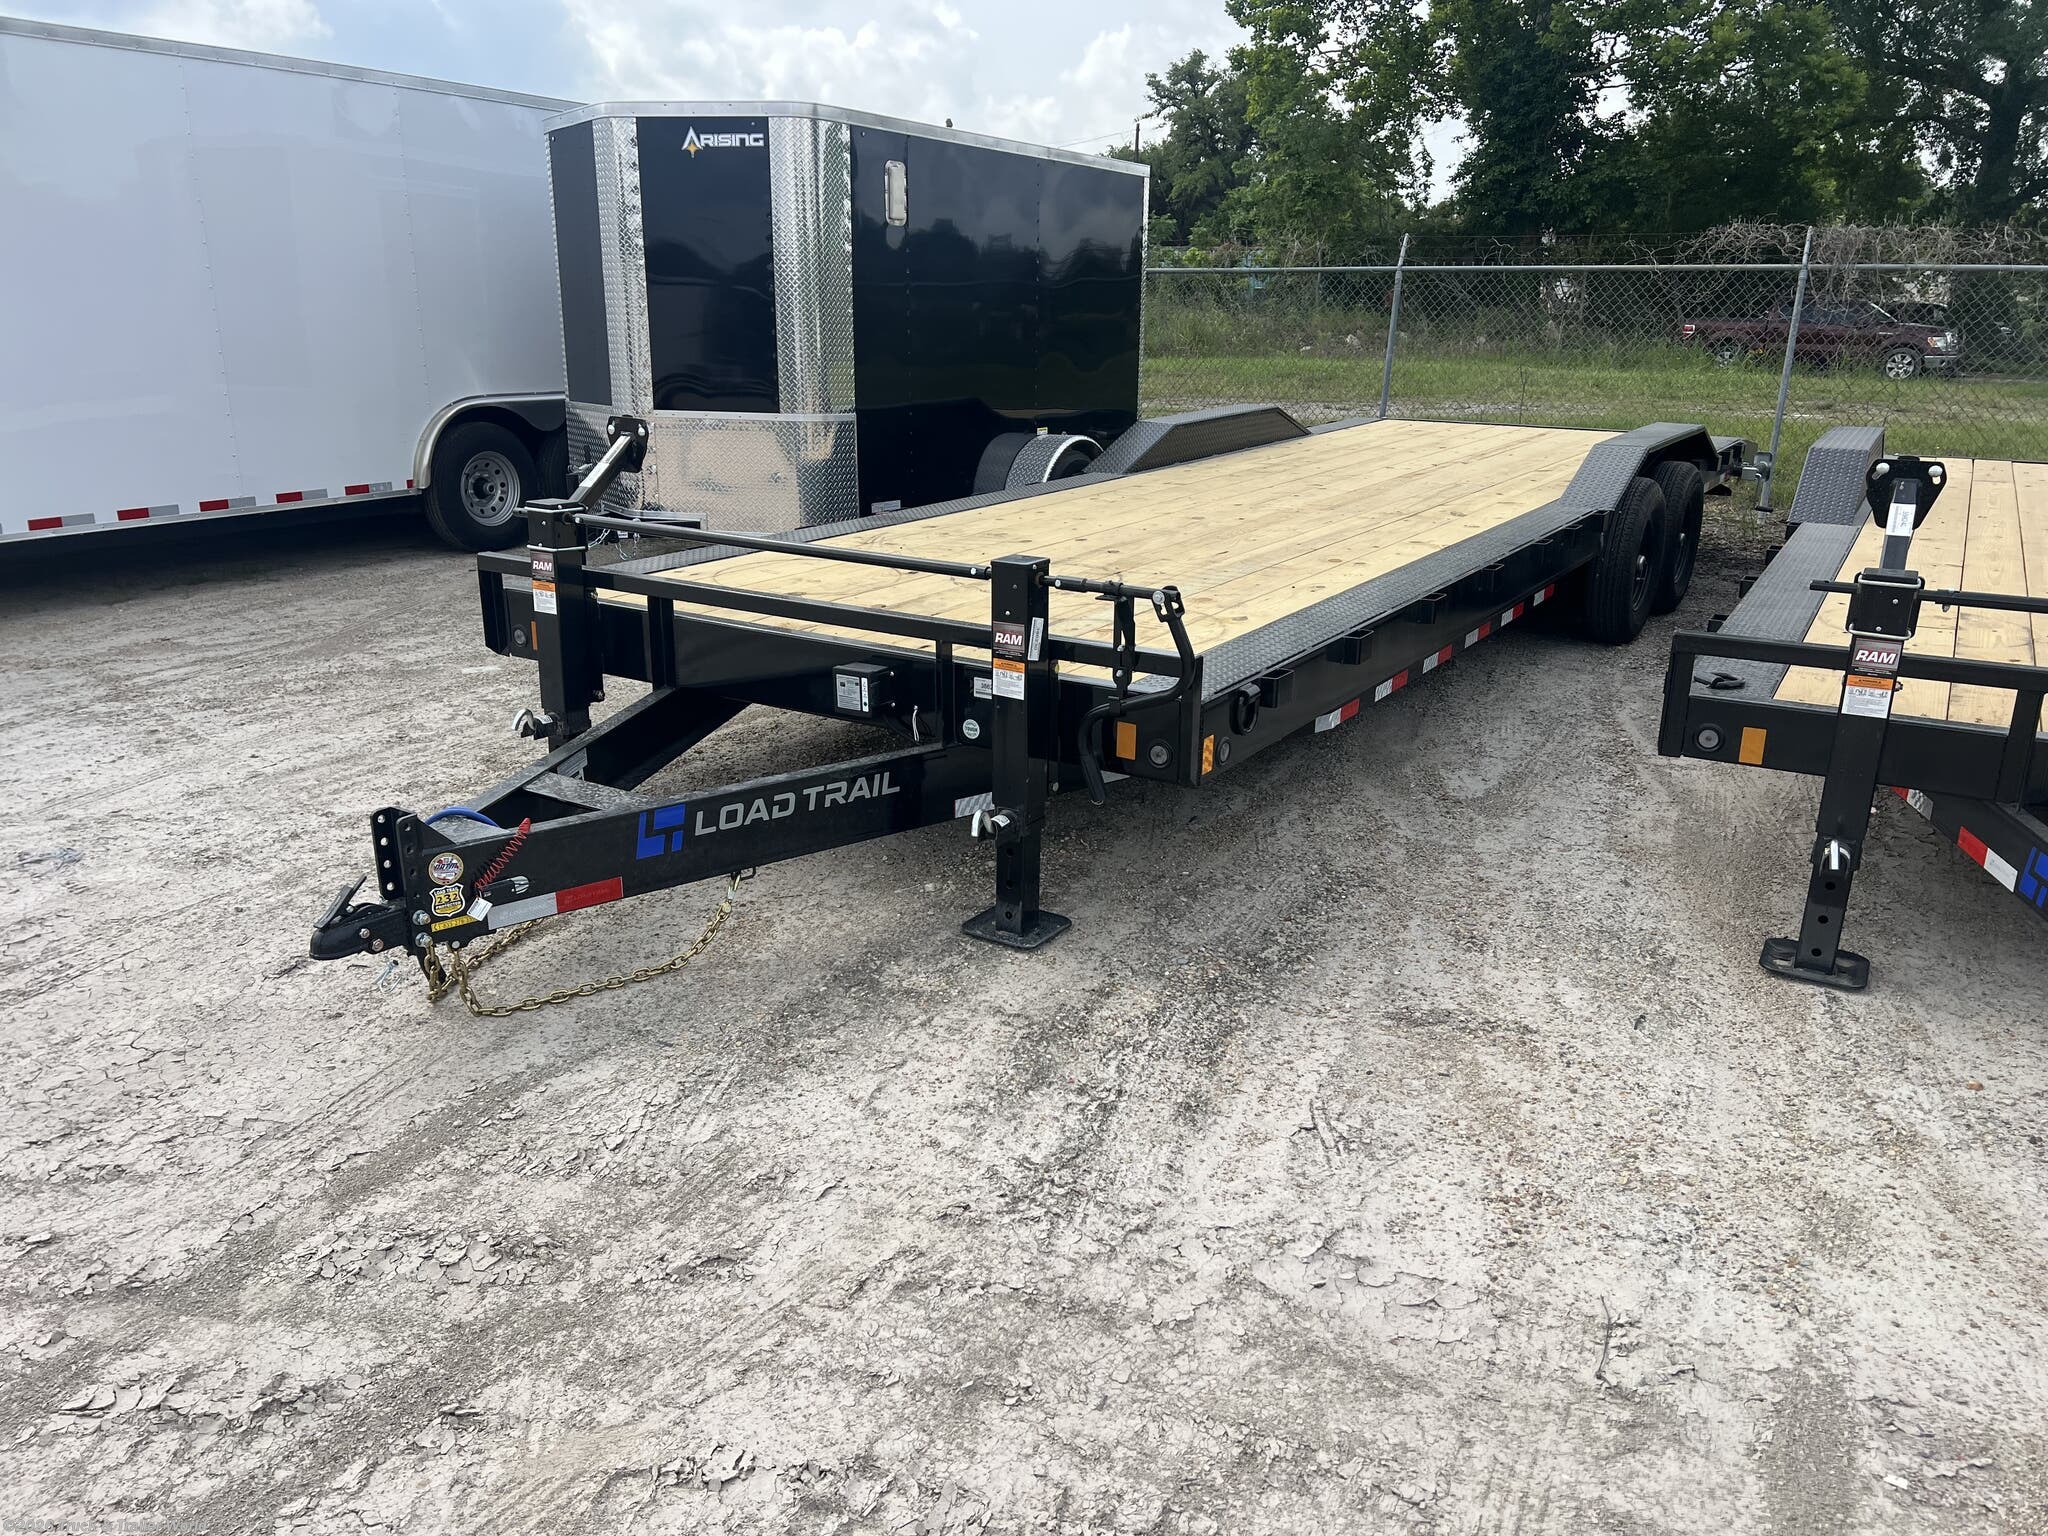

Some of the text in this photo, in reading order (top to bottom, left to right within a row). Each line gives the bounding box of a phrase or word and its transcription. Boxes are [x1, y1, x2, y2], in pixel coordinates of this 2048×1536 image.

[681, 126, 764, 150] ARISING
[532, 560, 552, 572] RAM
[994, 632, 1023, 646] RAM
[1855, 649, 1897, 665] RAM
[694, 791, 796, 837] LOAD
[802, 771, 901, 812] TRAIL
[437, 893, 459, 904] 232
